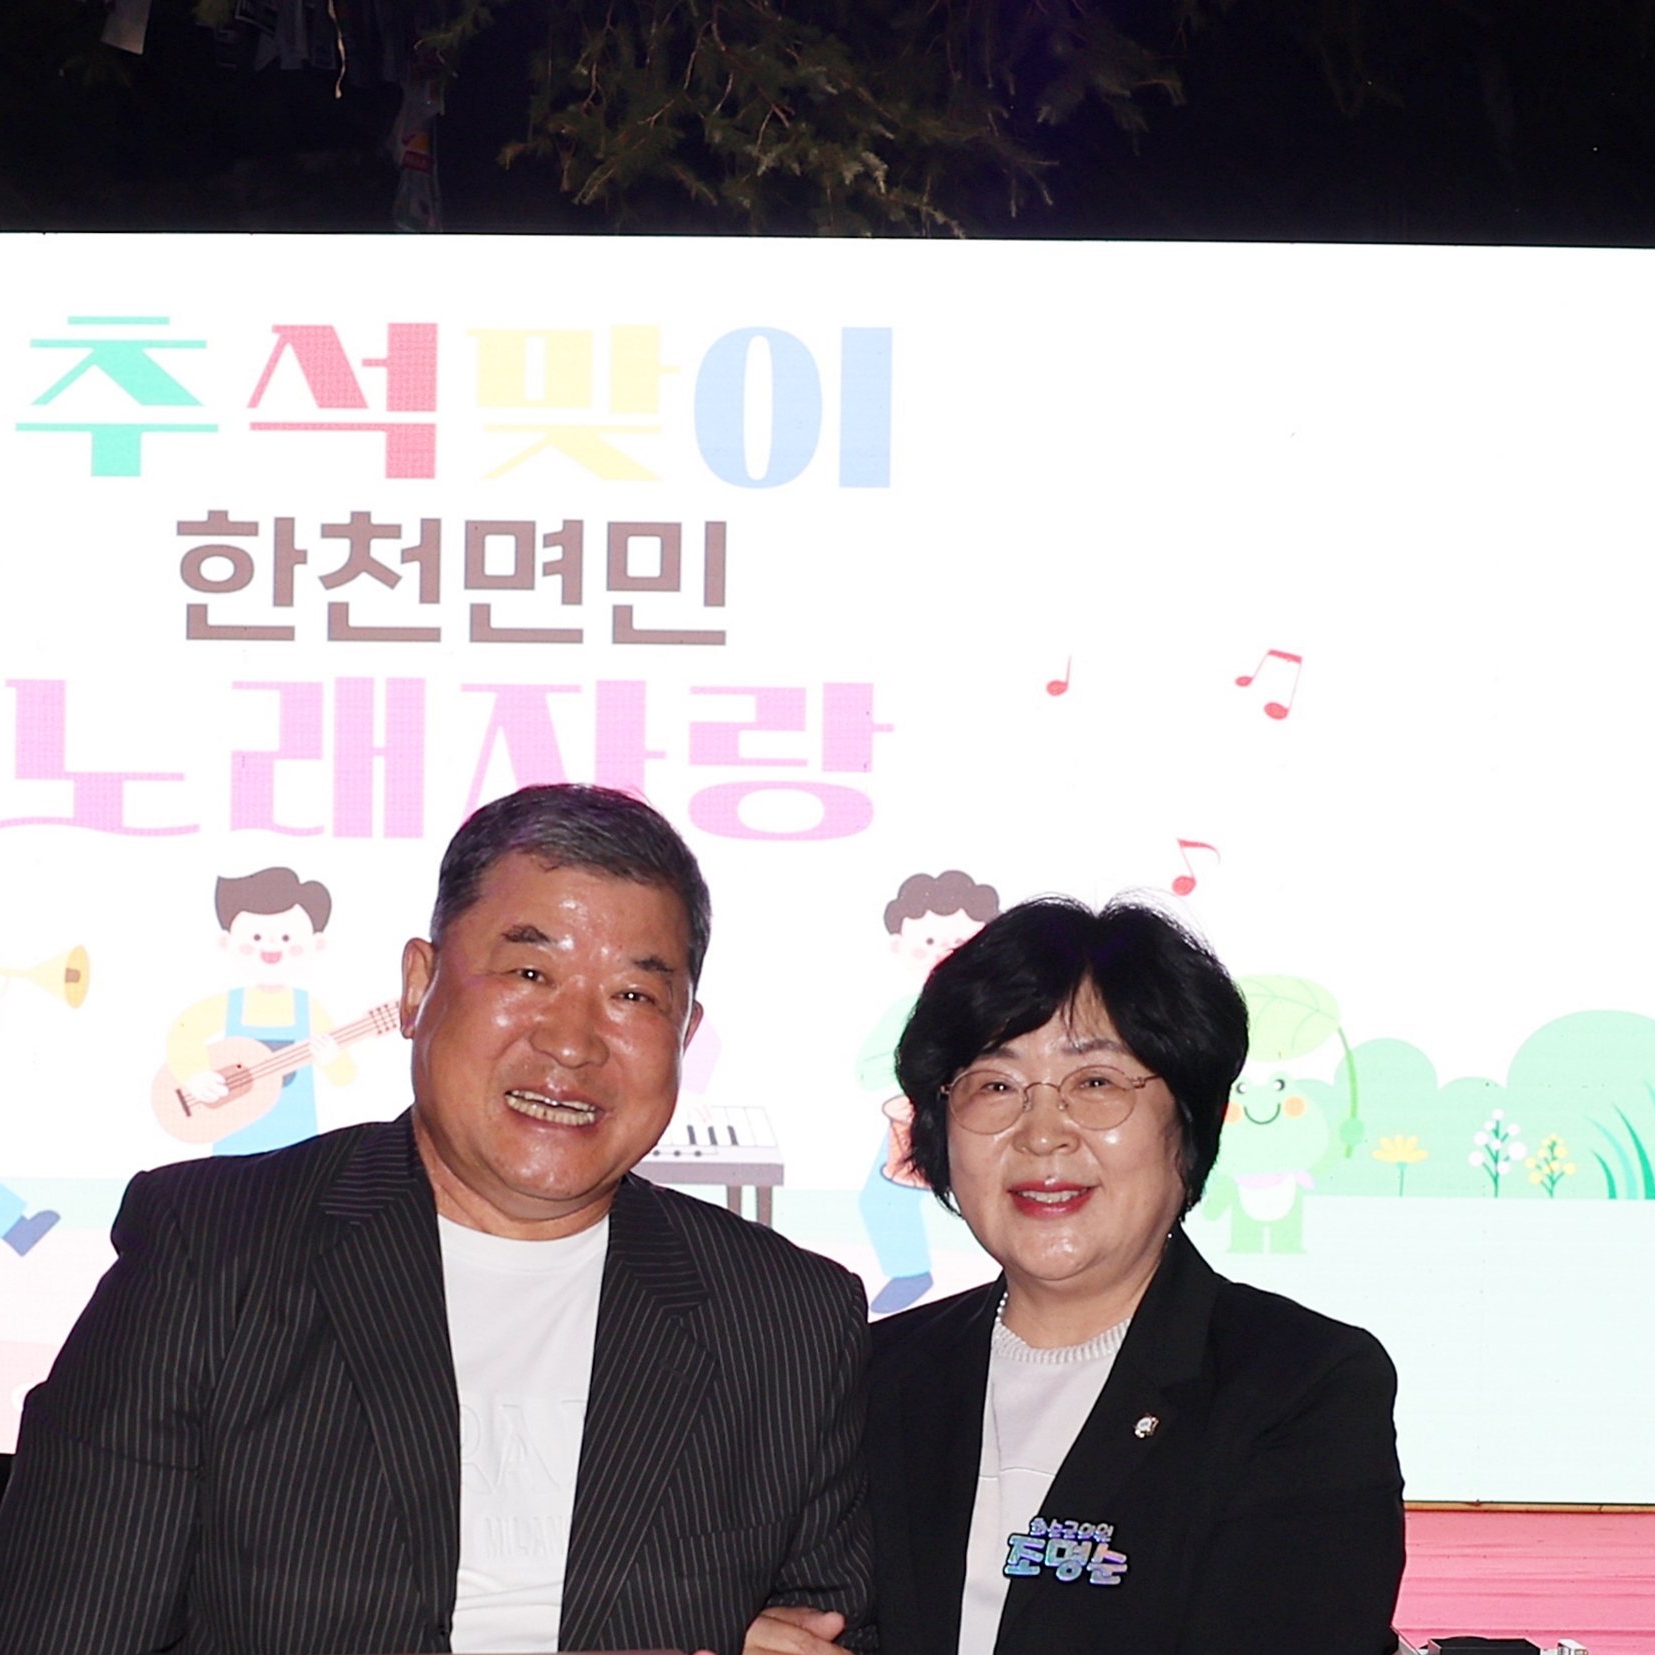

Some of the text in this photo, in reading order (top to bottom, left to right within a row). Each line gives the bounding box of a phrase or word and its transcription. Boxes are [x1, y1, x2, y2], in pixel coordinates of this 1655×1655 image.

[16, 316, 892, 489] 추석맞이
[176, 509, 727, 645] 한천면민
[1004, 1534, 1128, 1585] 조명순
